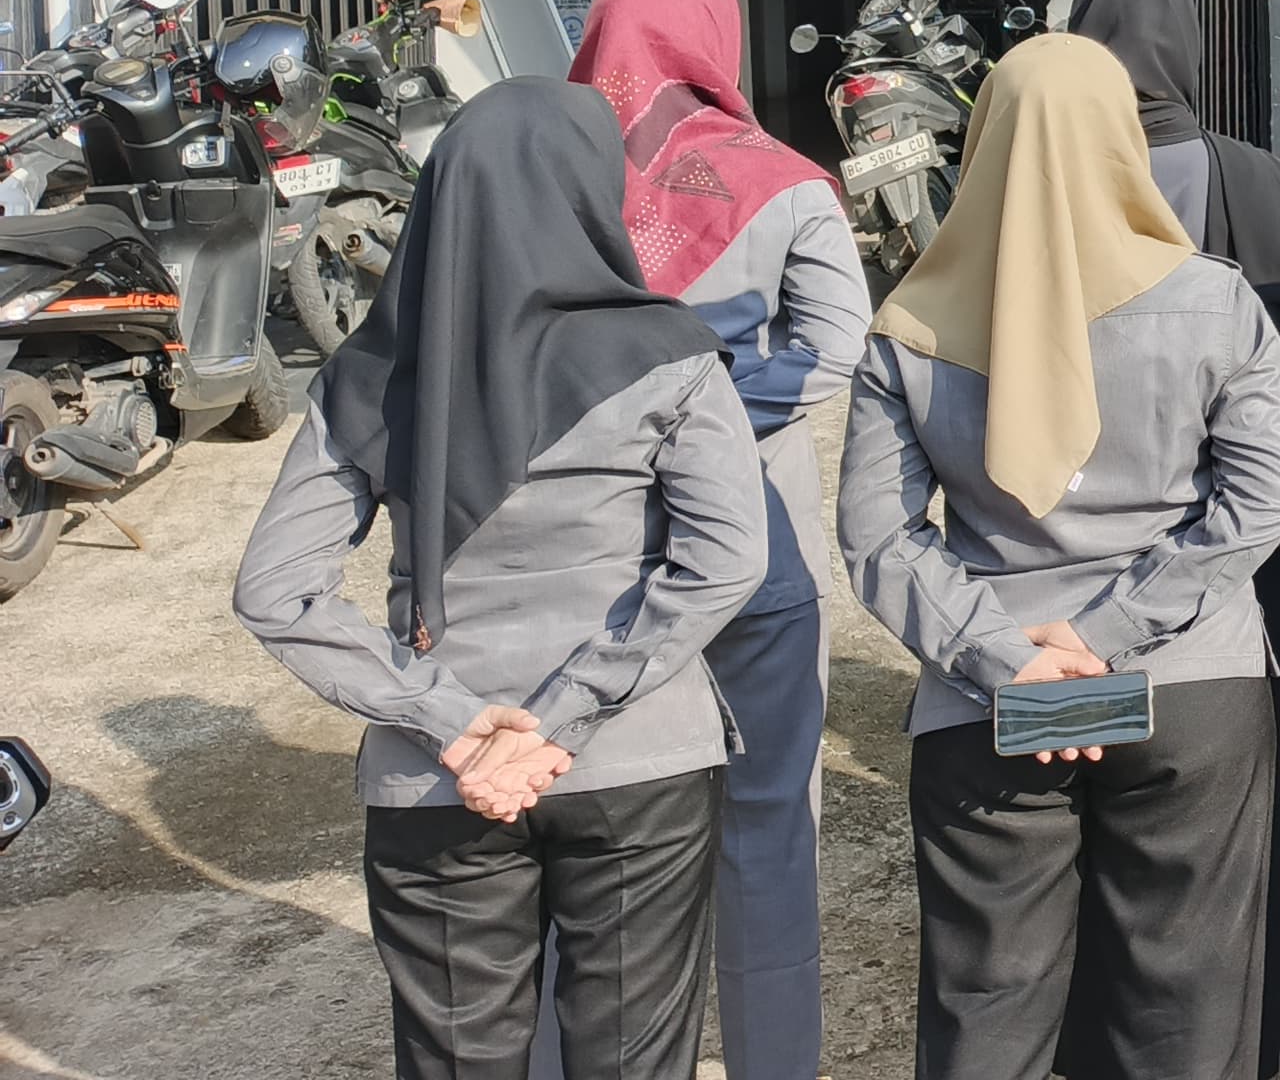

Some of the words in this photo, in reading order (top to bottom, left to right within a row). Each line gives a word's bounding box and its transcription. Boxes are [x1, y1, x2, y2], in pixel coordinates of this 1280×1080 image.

[846, 161, 863, 177] BG
[869, 146, 902, 167] 5804
[908, 136, 925, 151] CU
